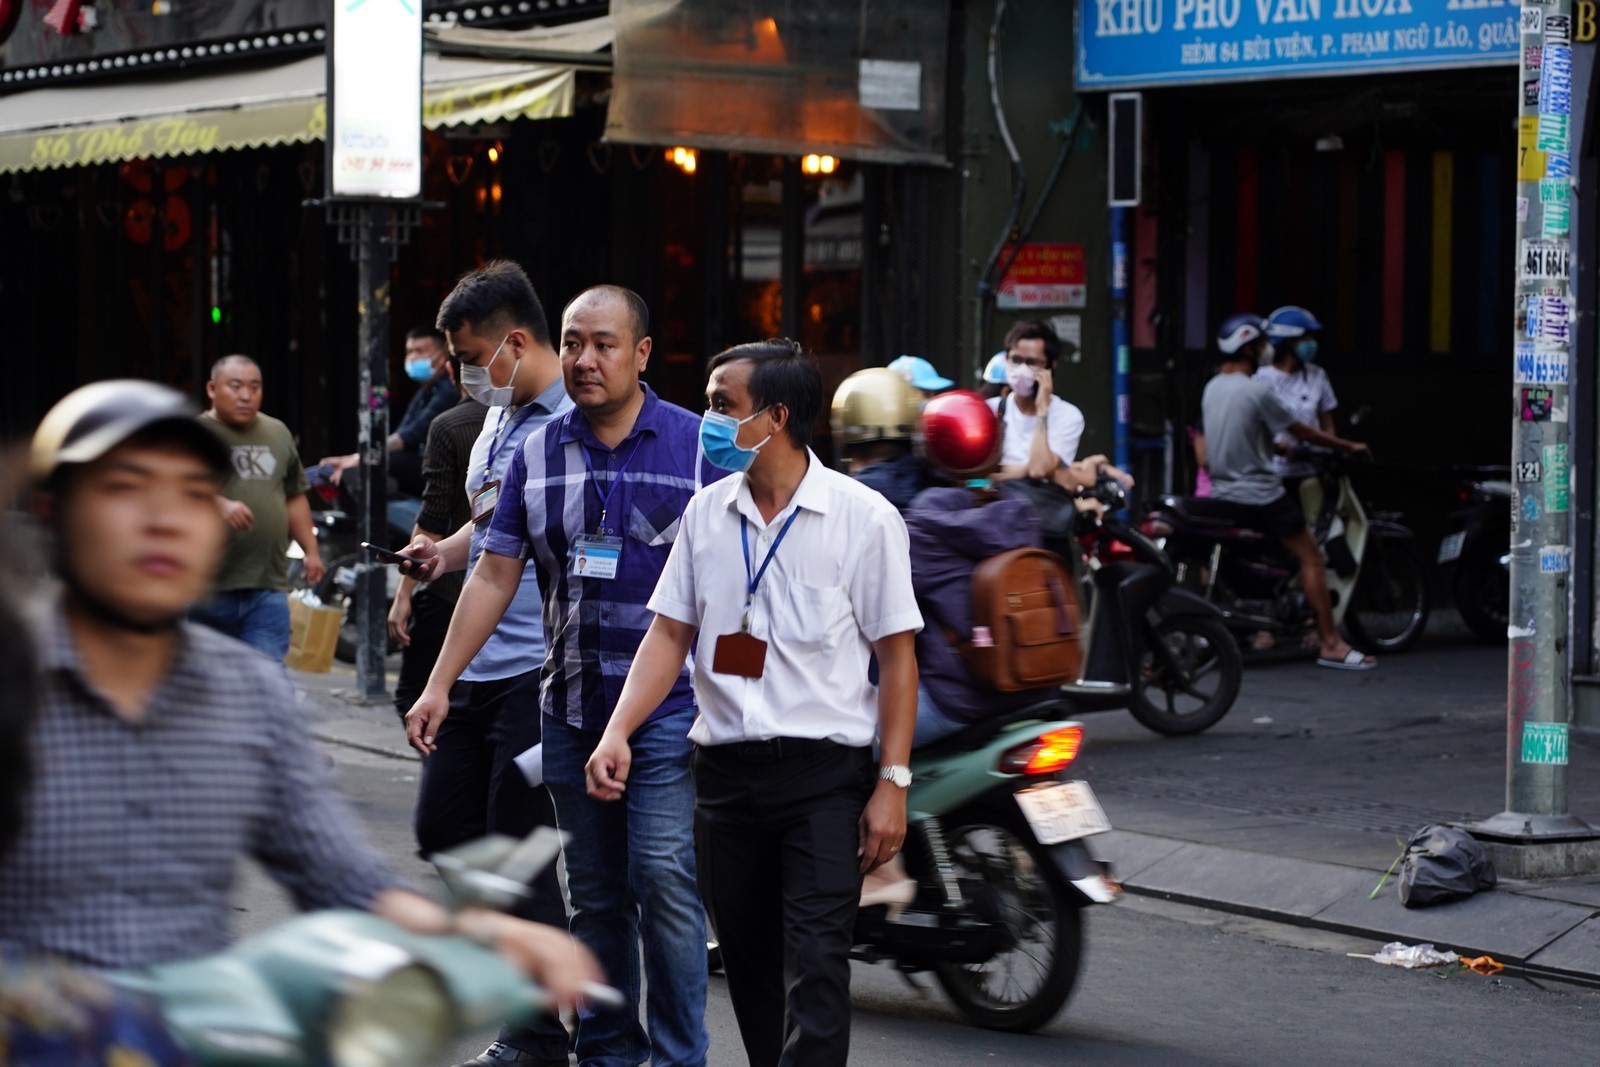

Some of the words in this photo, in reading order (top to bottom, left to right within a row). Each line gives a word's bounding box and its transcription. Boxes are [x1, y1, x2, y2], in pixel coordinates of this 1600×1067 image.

[1242, 33, 1271, 60] BÙI
[1321, 33, 1337, 55] P.
[1341, 30, 1389, 57] PHẠM
[1393, 21, 1429, 50] NGŨ
[1433, 19, 1473, 48] LÃO,
[154, 119, 220, 150] Tây
